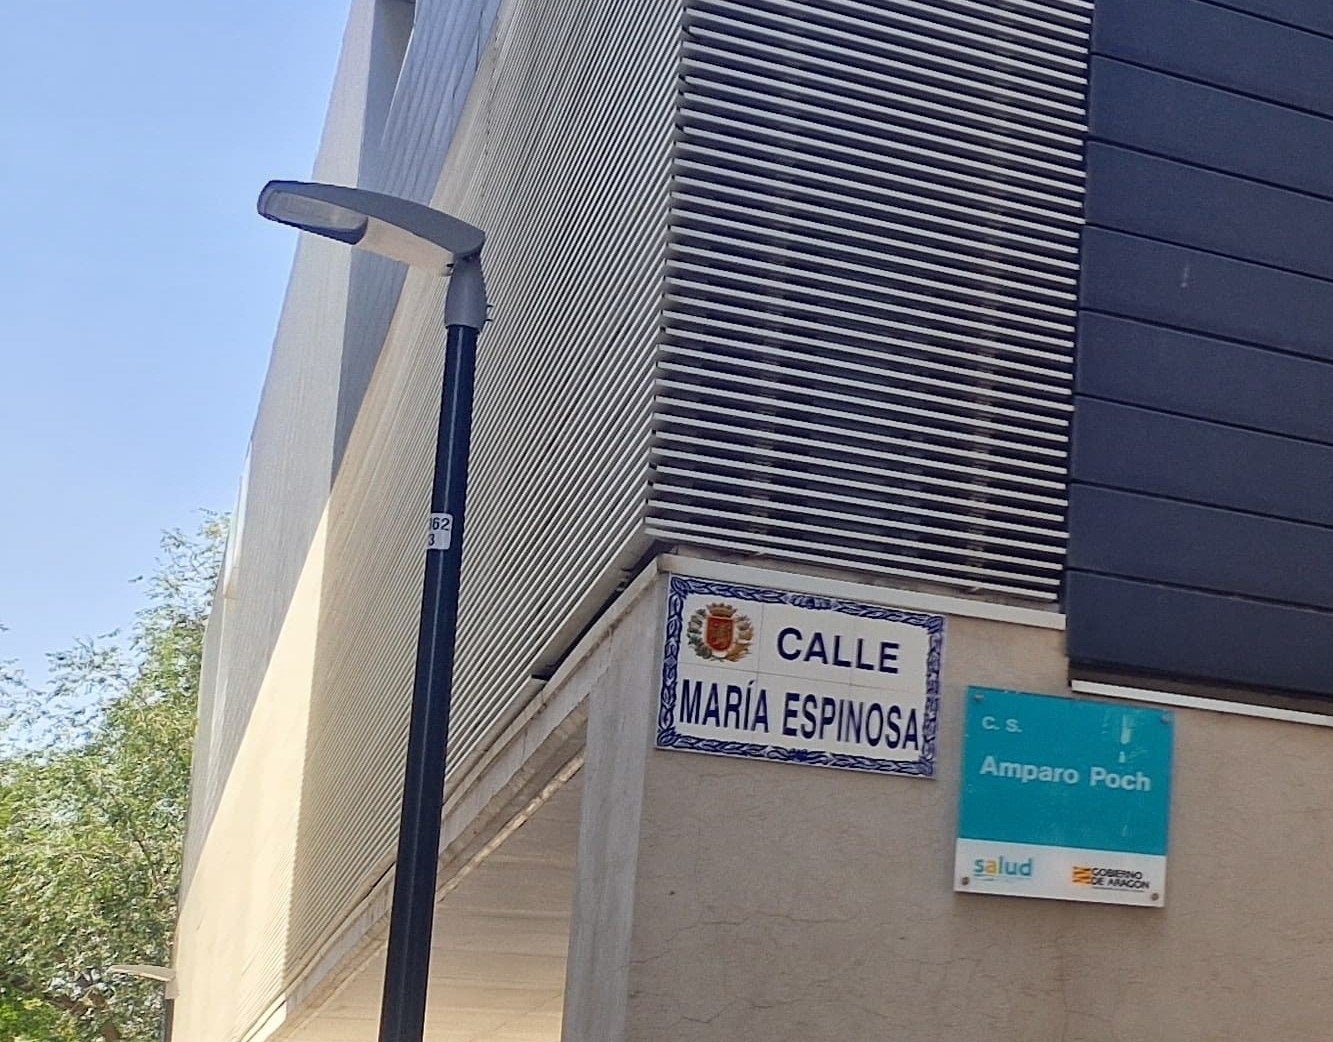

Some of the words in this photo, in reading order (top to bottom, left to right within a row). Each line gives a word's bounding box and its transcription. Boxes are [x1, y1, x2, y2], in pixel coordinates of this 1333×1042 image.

[777, 627, 900, 674] CALLE
[679, 679, 769, 733] MARÍA
[782, 692, 919, 750] ESPINOSA
[982, 716, 1000, 730] C.
[1005, 718, 1023, 733] S.
[979, 755, 1079, 785] Amparo
[1089, 766, 1152, 791] Poch
[973, 856, 1033, 877] salud
[1092, 867, 1143, 880] GOBIERNO
[1092, 876, 1104, 886] DE
